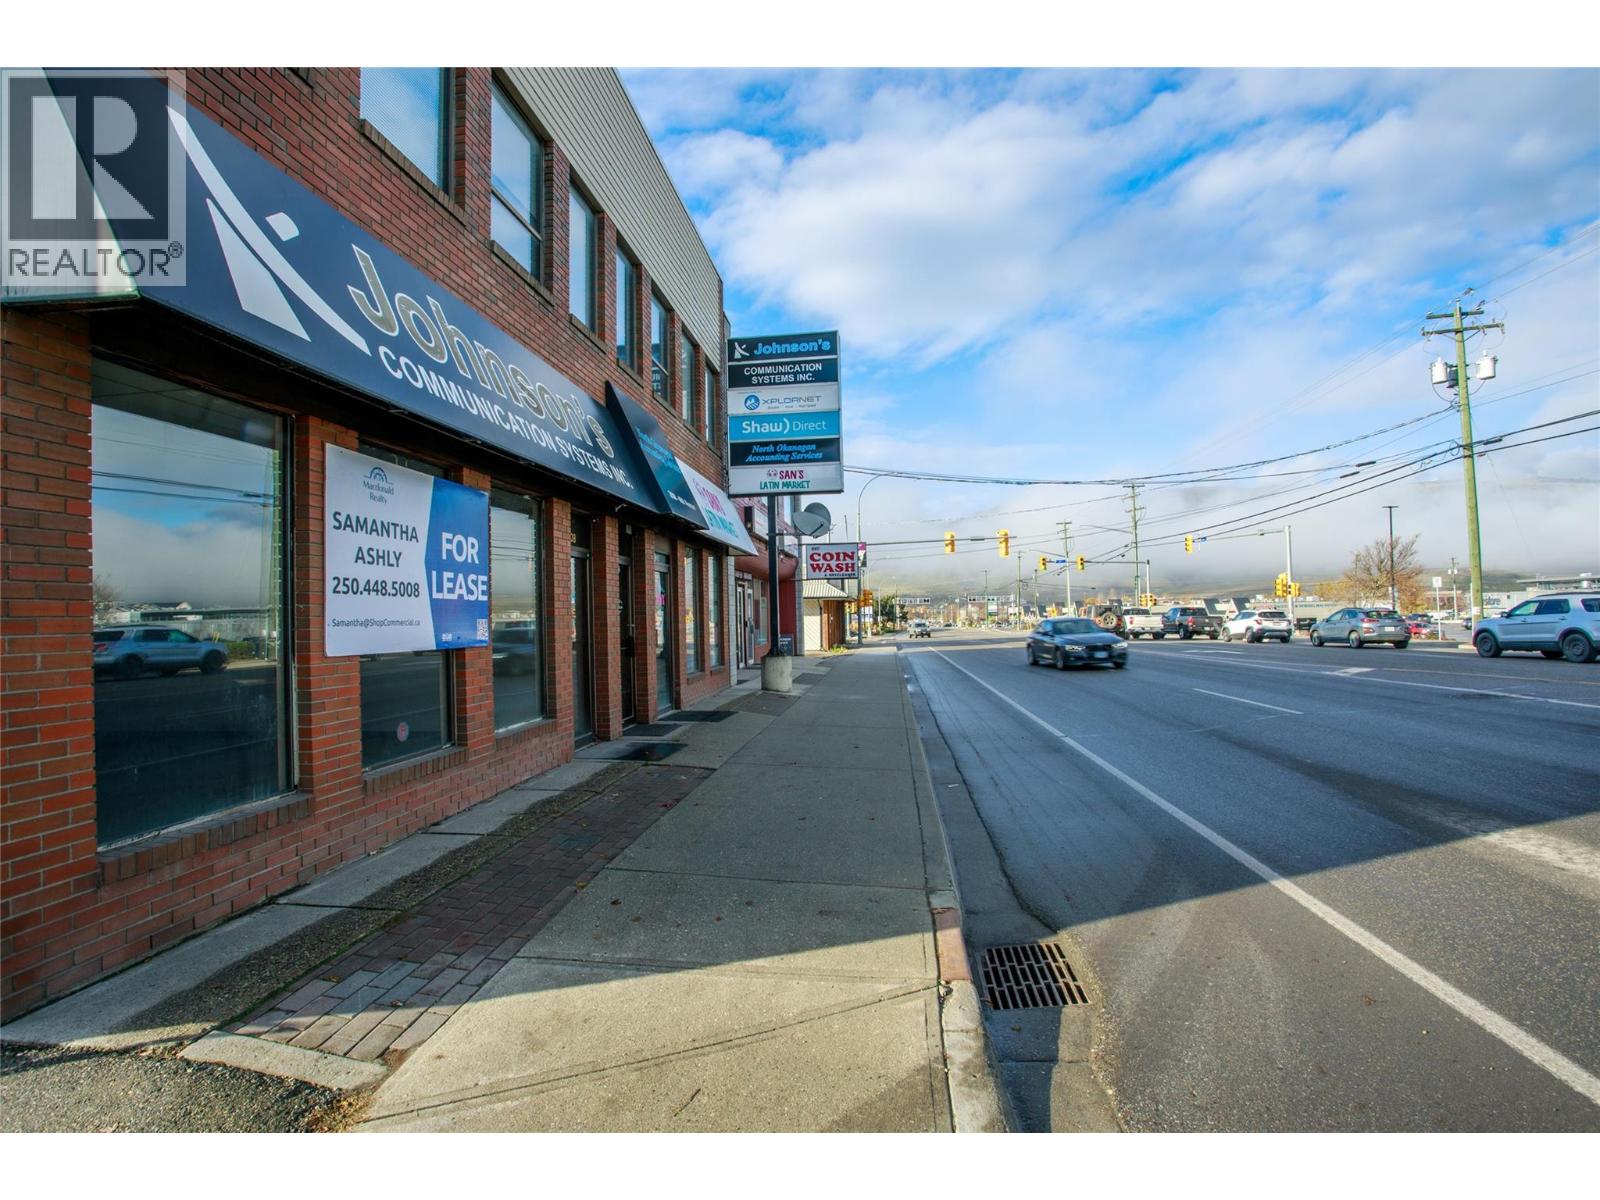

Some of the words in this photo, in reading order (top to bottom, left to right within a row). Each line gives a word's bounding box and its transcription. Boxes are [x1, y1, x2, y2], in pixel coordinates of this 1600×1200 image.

[346, 243, 615, 459] Johnson's
[754, 339, 831, 355] Johnson's
[744, 363, 823, 376] COMMUNICATION
[751, 374, 795, 384] SYSTEMS
[796, 373, 816, 382] INC.
[762, 395, 823, 406] XPLORNET
[378, 345, 558, 454] COMMUNICATION
[555, 436, 613, 477] SYSTEMS
[609, 465, 634, 489] INC.
[792, 420, 827, 431] Direct
[752, 445, 775, 454] North
[776, 444, 817, 453] Okanagan
[745, 454, 790, 462] Accounting
[791, 452, 823, 460] Services
[363, 480, 395, 496] Macdonald
[759, 481, 780, 490] LATIN
[781, 480, 811, 489] MARKET
[369, 492, 387, 505] Realty
[332, 511, 419, 543] SAMANTHA
[441, 531, 480, 564] FOR
[354, 546, 403, 568] ASHLY
[809, 551, 856, 562] COIN
[809, 562, 856, 573] WASH
[332, 576, 420, 598] 250.448.5008
[431, 570, 488, 601] LEASE
